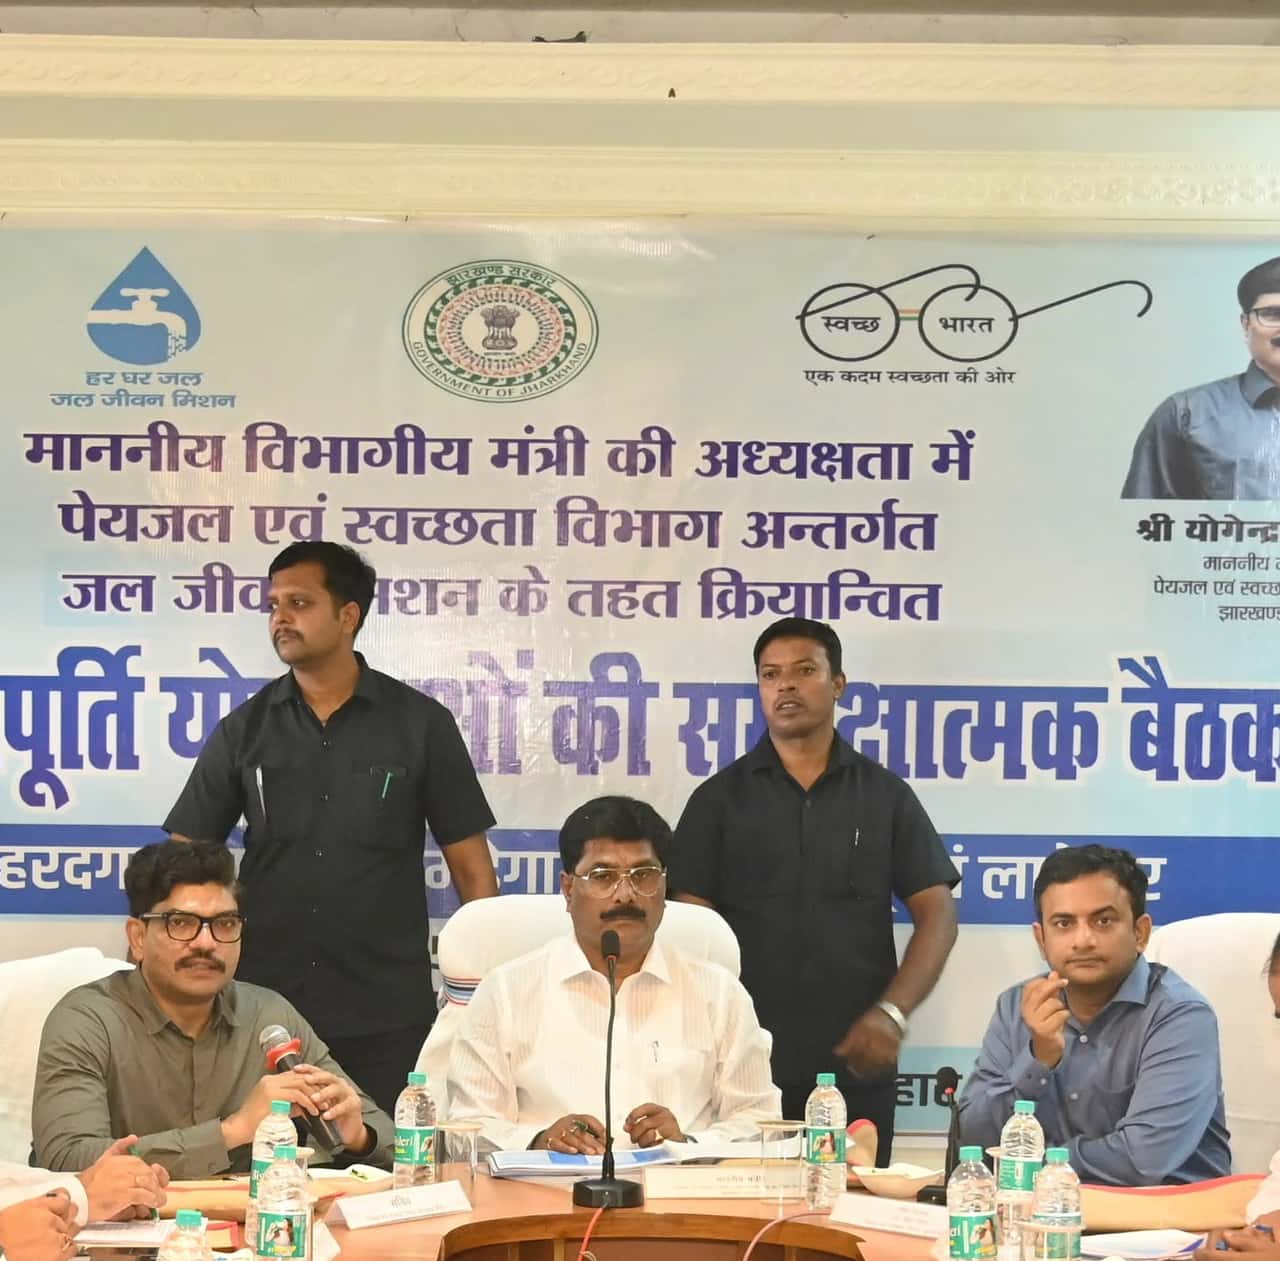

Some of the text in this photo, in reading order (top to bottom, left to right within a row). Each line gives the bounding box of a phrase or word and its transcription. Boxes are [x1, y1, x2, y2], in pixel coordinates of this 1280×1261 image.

[822, 316, 881, 333] स्वच्छ
[938, 317, 995, 333] भारत
[86, 372, 203, 387] हर घर जल
[413, 341, 588, 397] GOVERNMENT OF JHARKHAND
[803, 366, 1017, 387] एक कदम स्वच्छता की ओर
[50, 389, 236, 408] जल जीवन मिशन
[23, 420, 976, 482] माननीय विभागीय मंत्री की अध्यक्षता में
[58, 490, 938, 551] पेयजल एवं स्वच्छता विभाग अन्तर्गत
[1136, 513, 1175, 542] श्री
[1184, 513, 1280, 544] योगेन्द्र
[1203, 552, 1270, 572] माननीय
[62, 574, 156, 613] जल
[172, 562, 273, 613] जीव
[498, 565, 550, 618] के
[566, 580, 681, 620] तहत
[697, 567, 943, 621] क्रियान्वित
[1153, 575, 1208, 595] पेयजल
[1213, 578, 1235, 596] एवं
[543, 651, 660, 777] की
